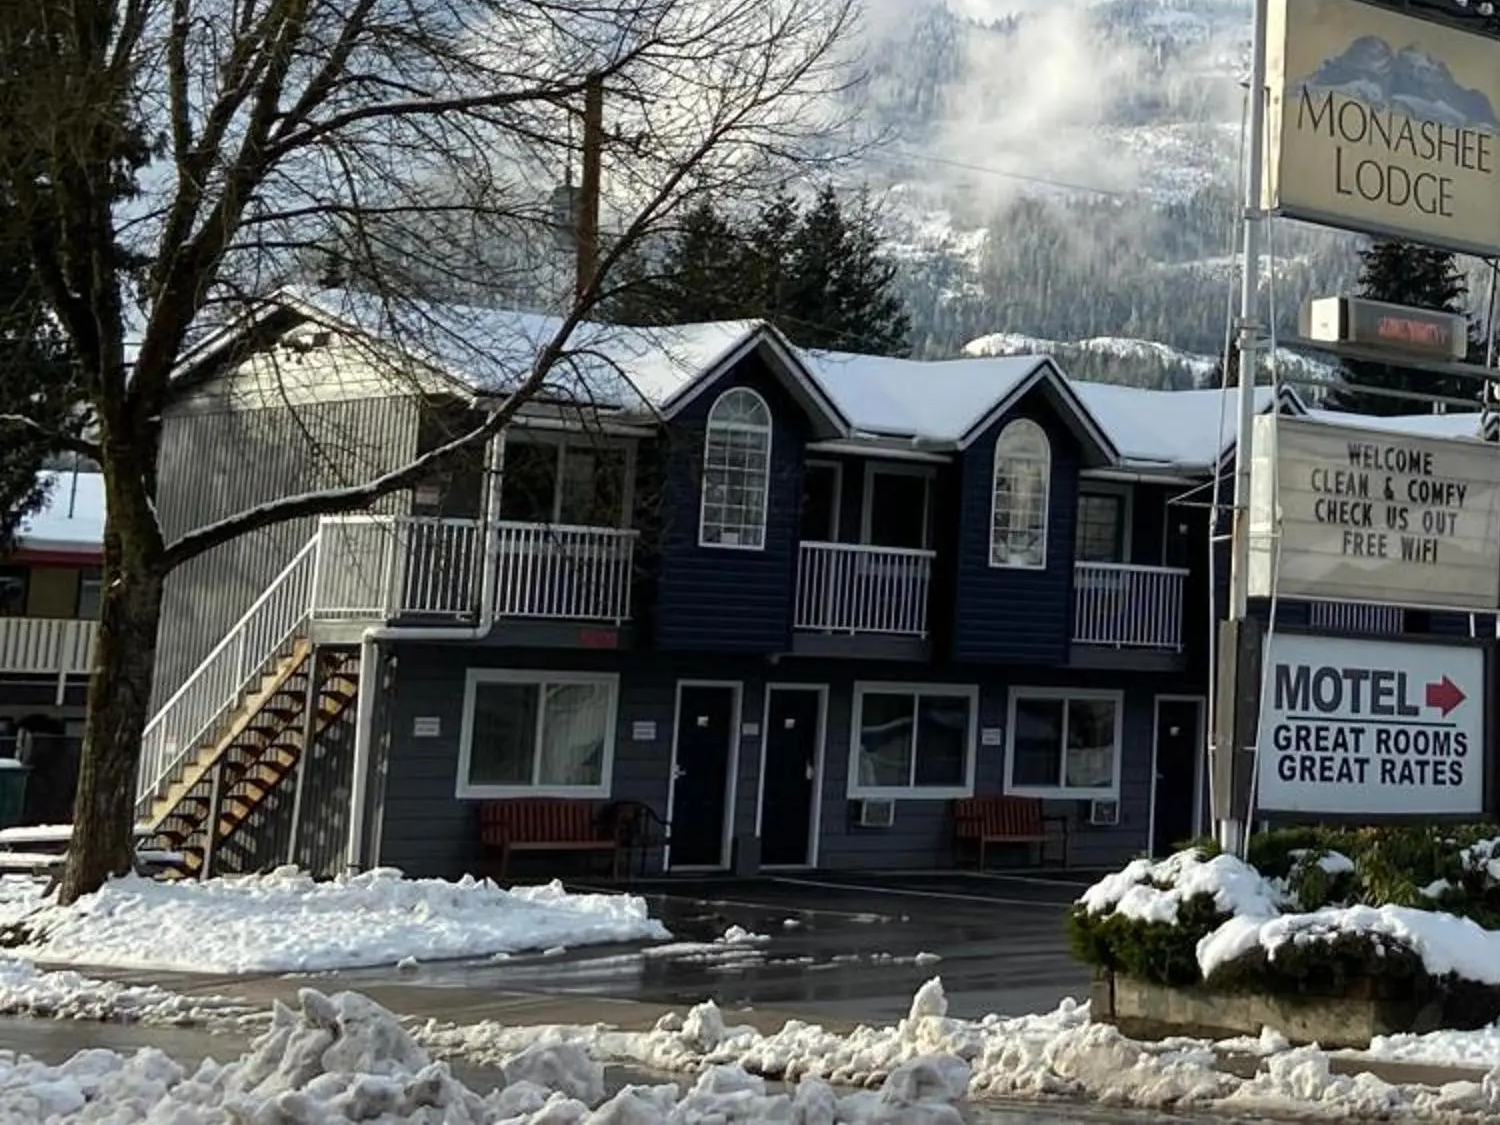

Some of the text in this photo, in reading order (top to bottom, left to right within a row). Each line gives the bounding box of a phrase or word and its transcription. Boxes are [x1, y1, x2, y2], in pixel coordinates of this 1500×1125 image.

[1298, 85, 1493, 173] MONASHEE
[1335, 147, 1454, 217] LODGE
[1348, 443, 1433, 476] WELCOME
[1311, 468, 1467, 507] CLEAN & COMFY
[1315, 498, 1458, 536] CHECK US OUT
[1342, 531, 1388, 558] FREE
[1274, 664, 1420, 717] MOTEL
[1273, 724, 1468, 758] GREAT ROOMS
[1278, 755, 1464, 786] GREAT RATES
